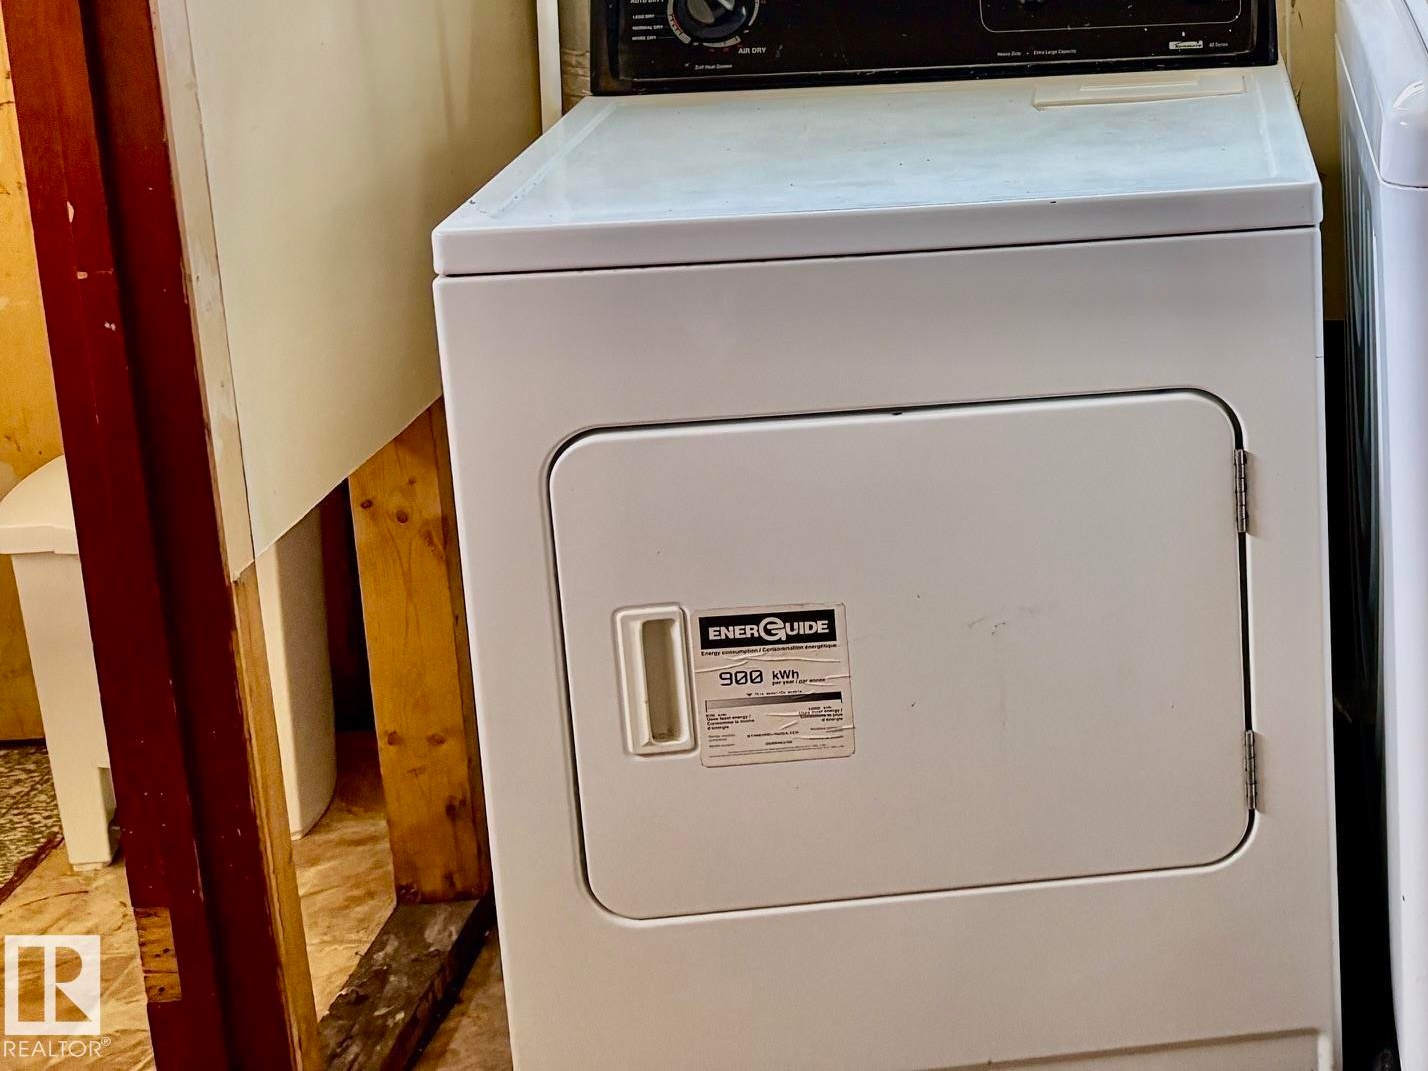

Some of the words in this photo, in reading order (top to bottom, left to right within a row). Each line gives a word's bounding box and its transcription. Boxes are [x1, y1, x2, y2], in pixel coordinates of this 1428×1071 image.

[738, 47, 751, 55] AIR
[751, 46, 767, 54] DRY
[707, 616, 830, 642] ENERGUIDE
[721, 648, 759, 656] consumption
[719, 669, 764, 687] 900
[772, 669, 799, 680] kWh
